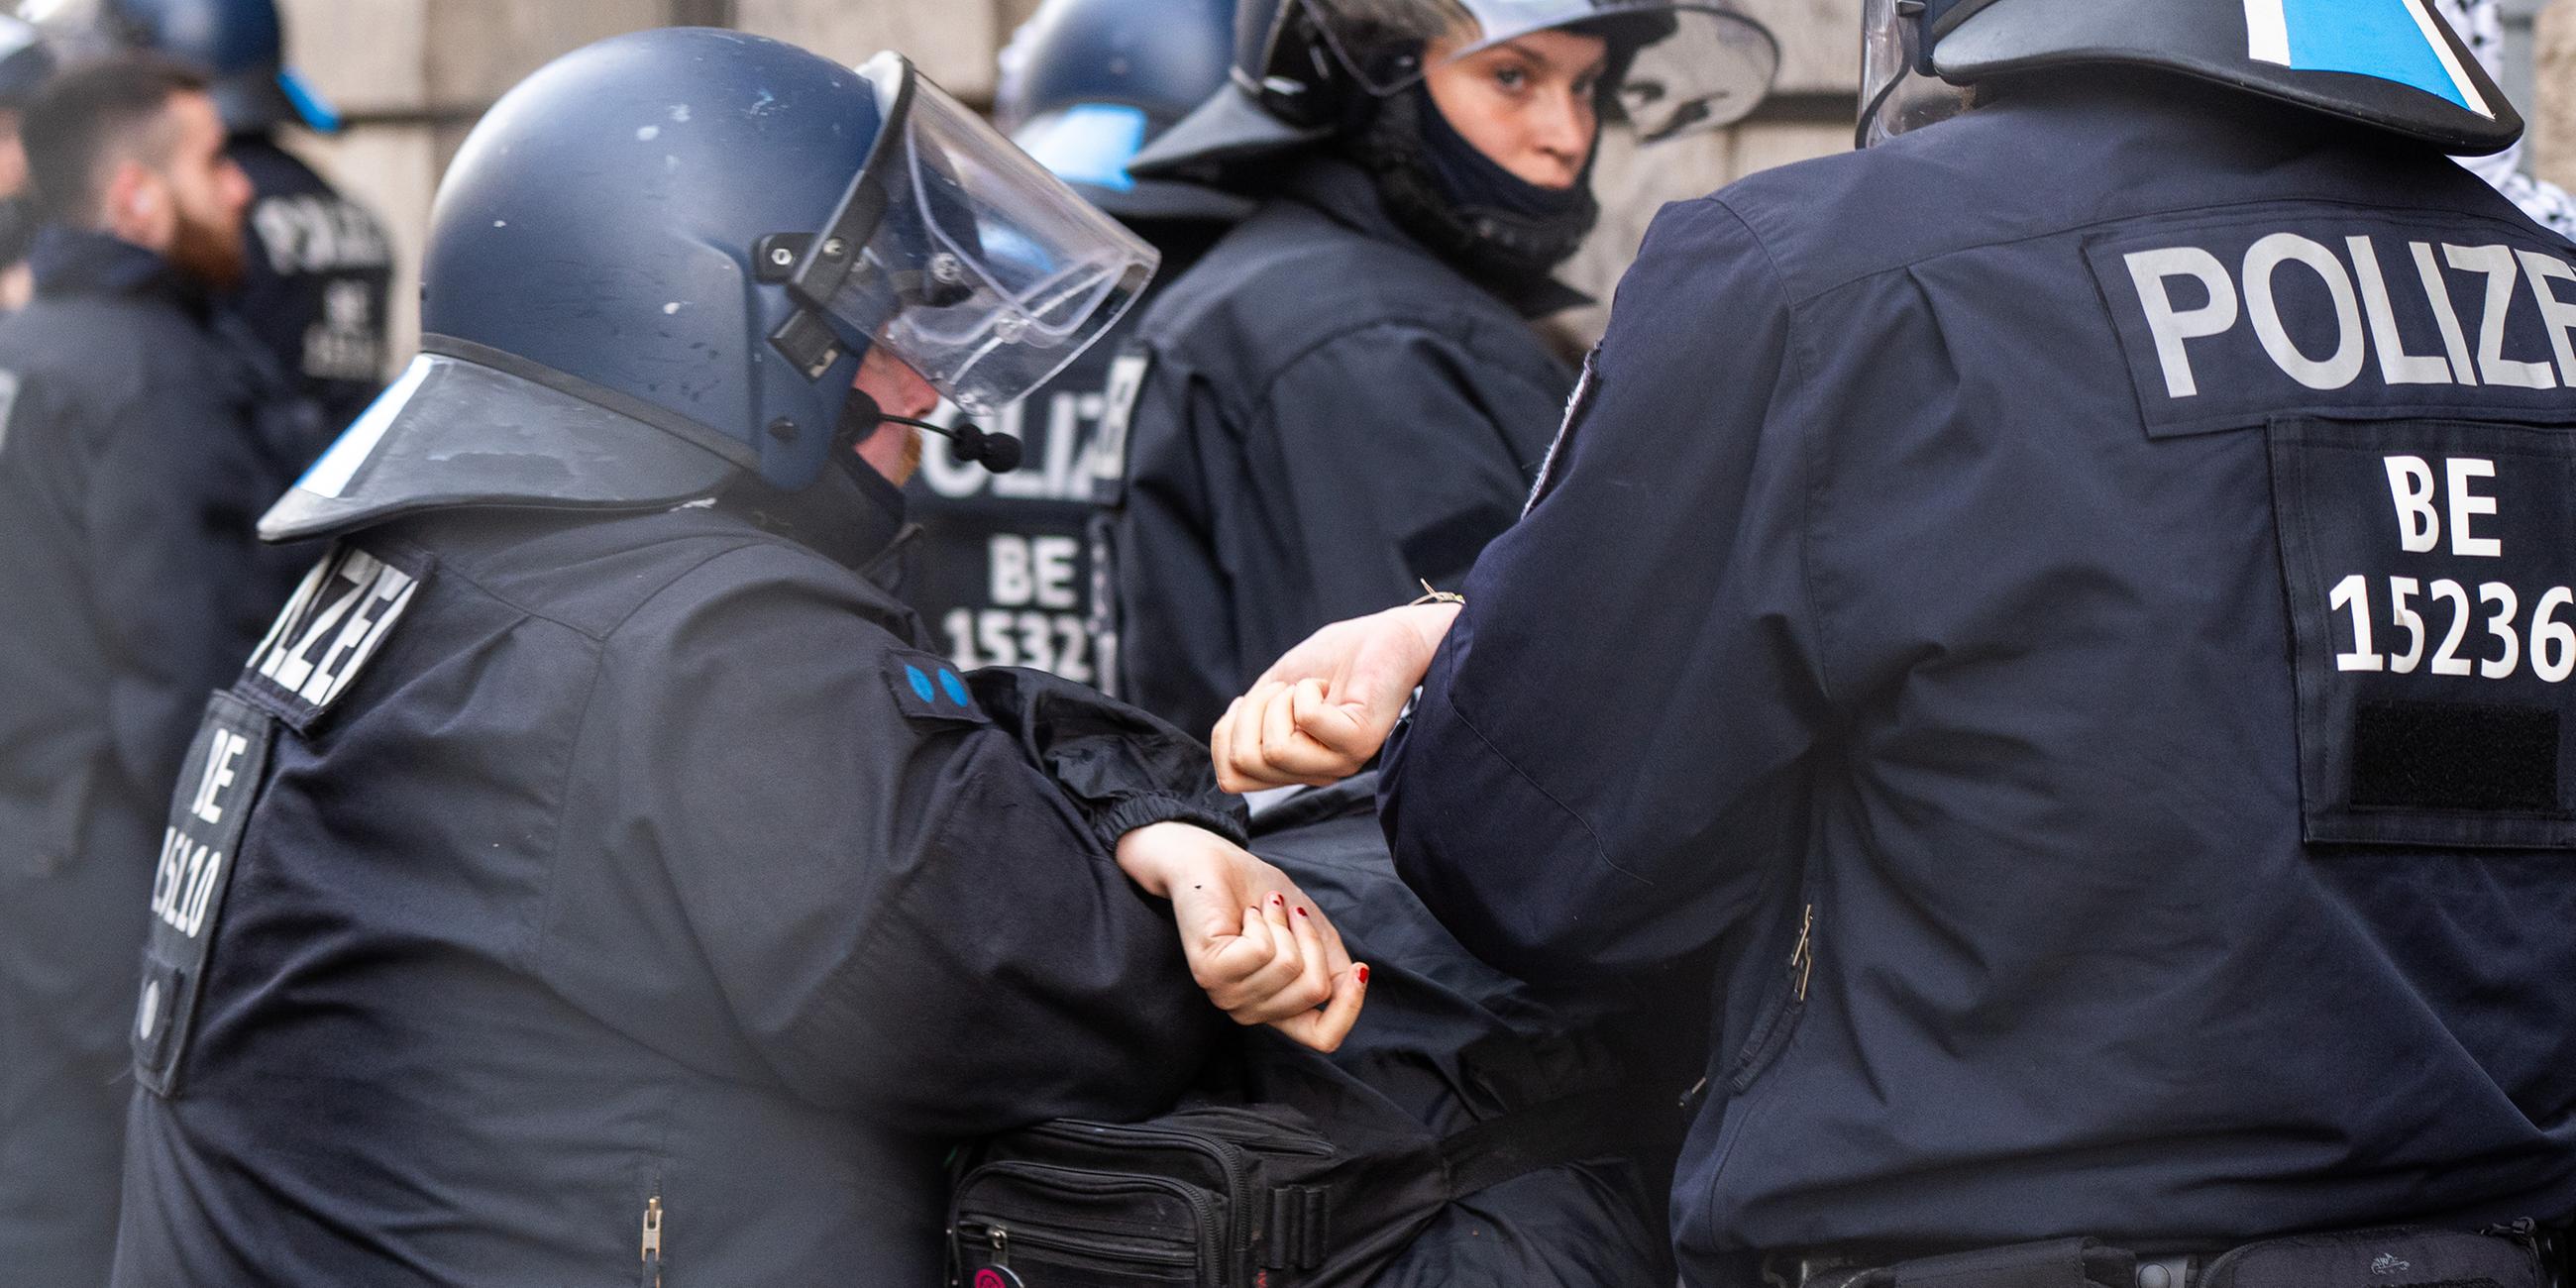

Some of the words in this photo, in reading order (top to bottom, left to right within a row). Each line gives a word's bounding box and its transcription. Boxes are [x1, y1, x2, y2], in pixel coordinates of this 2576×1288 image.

[2383, 455, 2502, 557] BE
[989, 533, 1078, 608] BE
[2329, 574, 2576, 683] 15236
